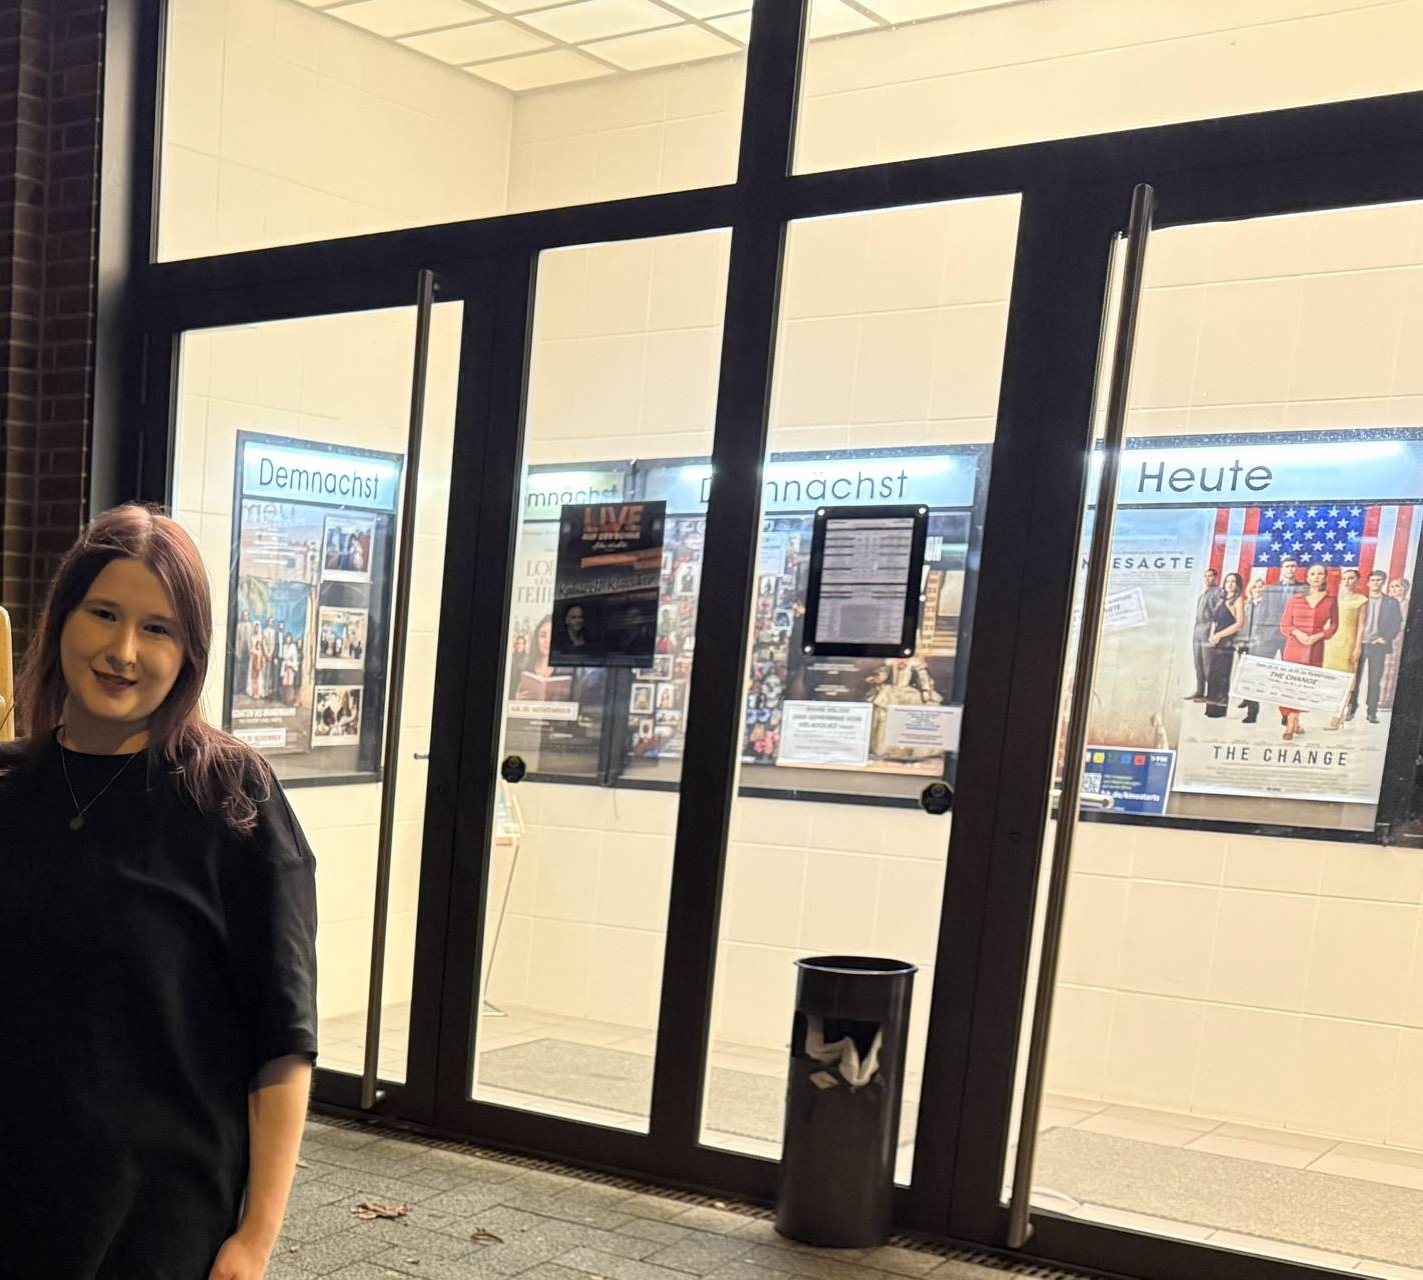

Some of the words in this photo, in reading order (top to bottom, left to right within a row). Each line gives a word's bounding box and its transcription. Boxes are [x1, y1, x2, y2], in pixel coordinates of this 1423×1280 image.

[1137, 459, 1273, 493] Heute
[583, 504, 644, 532] LIVE
[1213, 745, 1250, 761] THE
[1263, 748, 1349, 767] CHANGE
